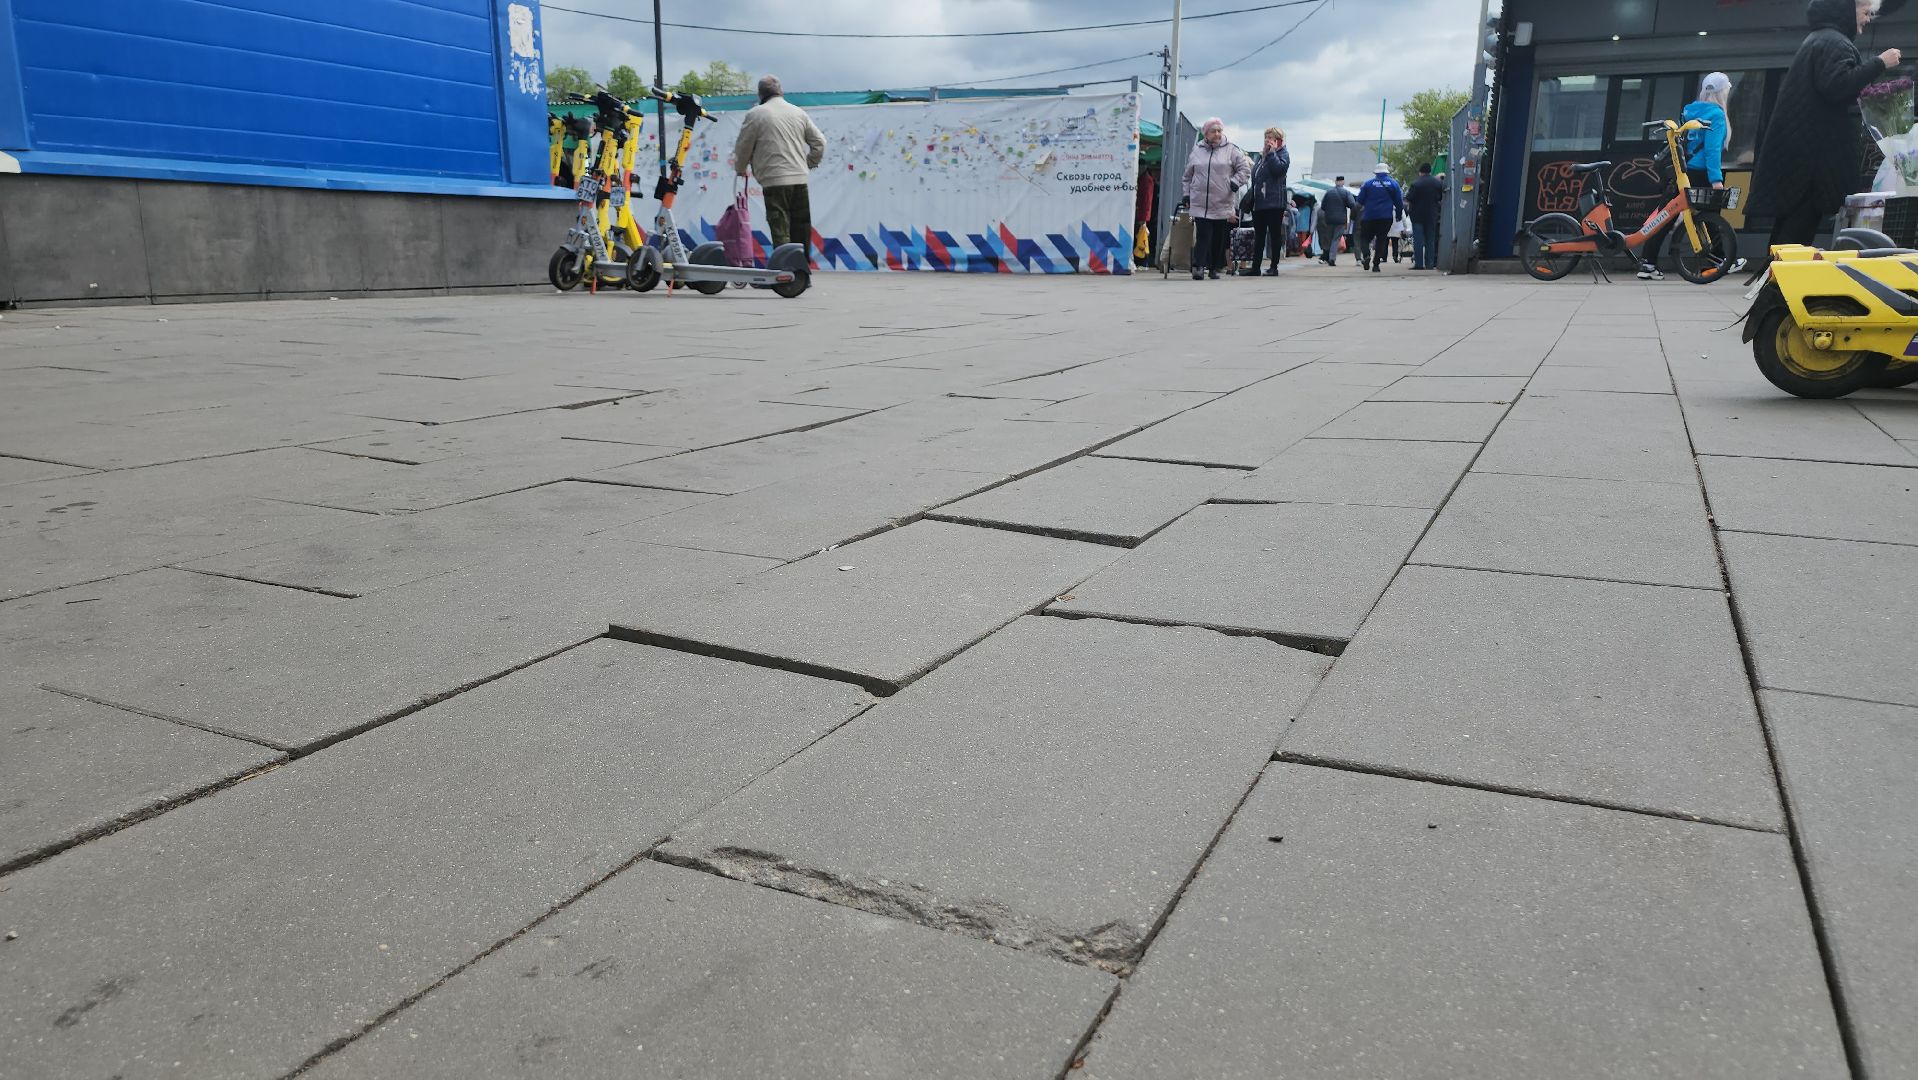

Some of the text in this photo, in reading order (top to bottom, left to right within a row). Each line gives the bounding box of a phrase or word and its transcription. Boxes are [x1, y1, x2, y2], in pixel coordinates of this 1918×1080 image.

[1056, 172, 1122, 183] Сквозь город
[1070, 182, 1111, 195] удобнее
